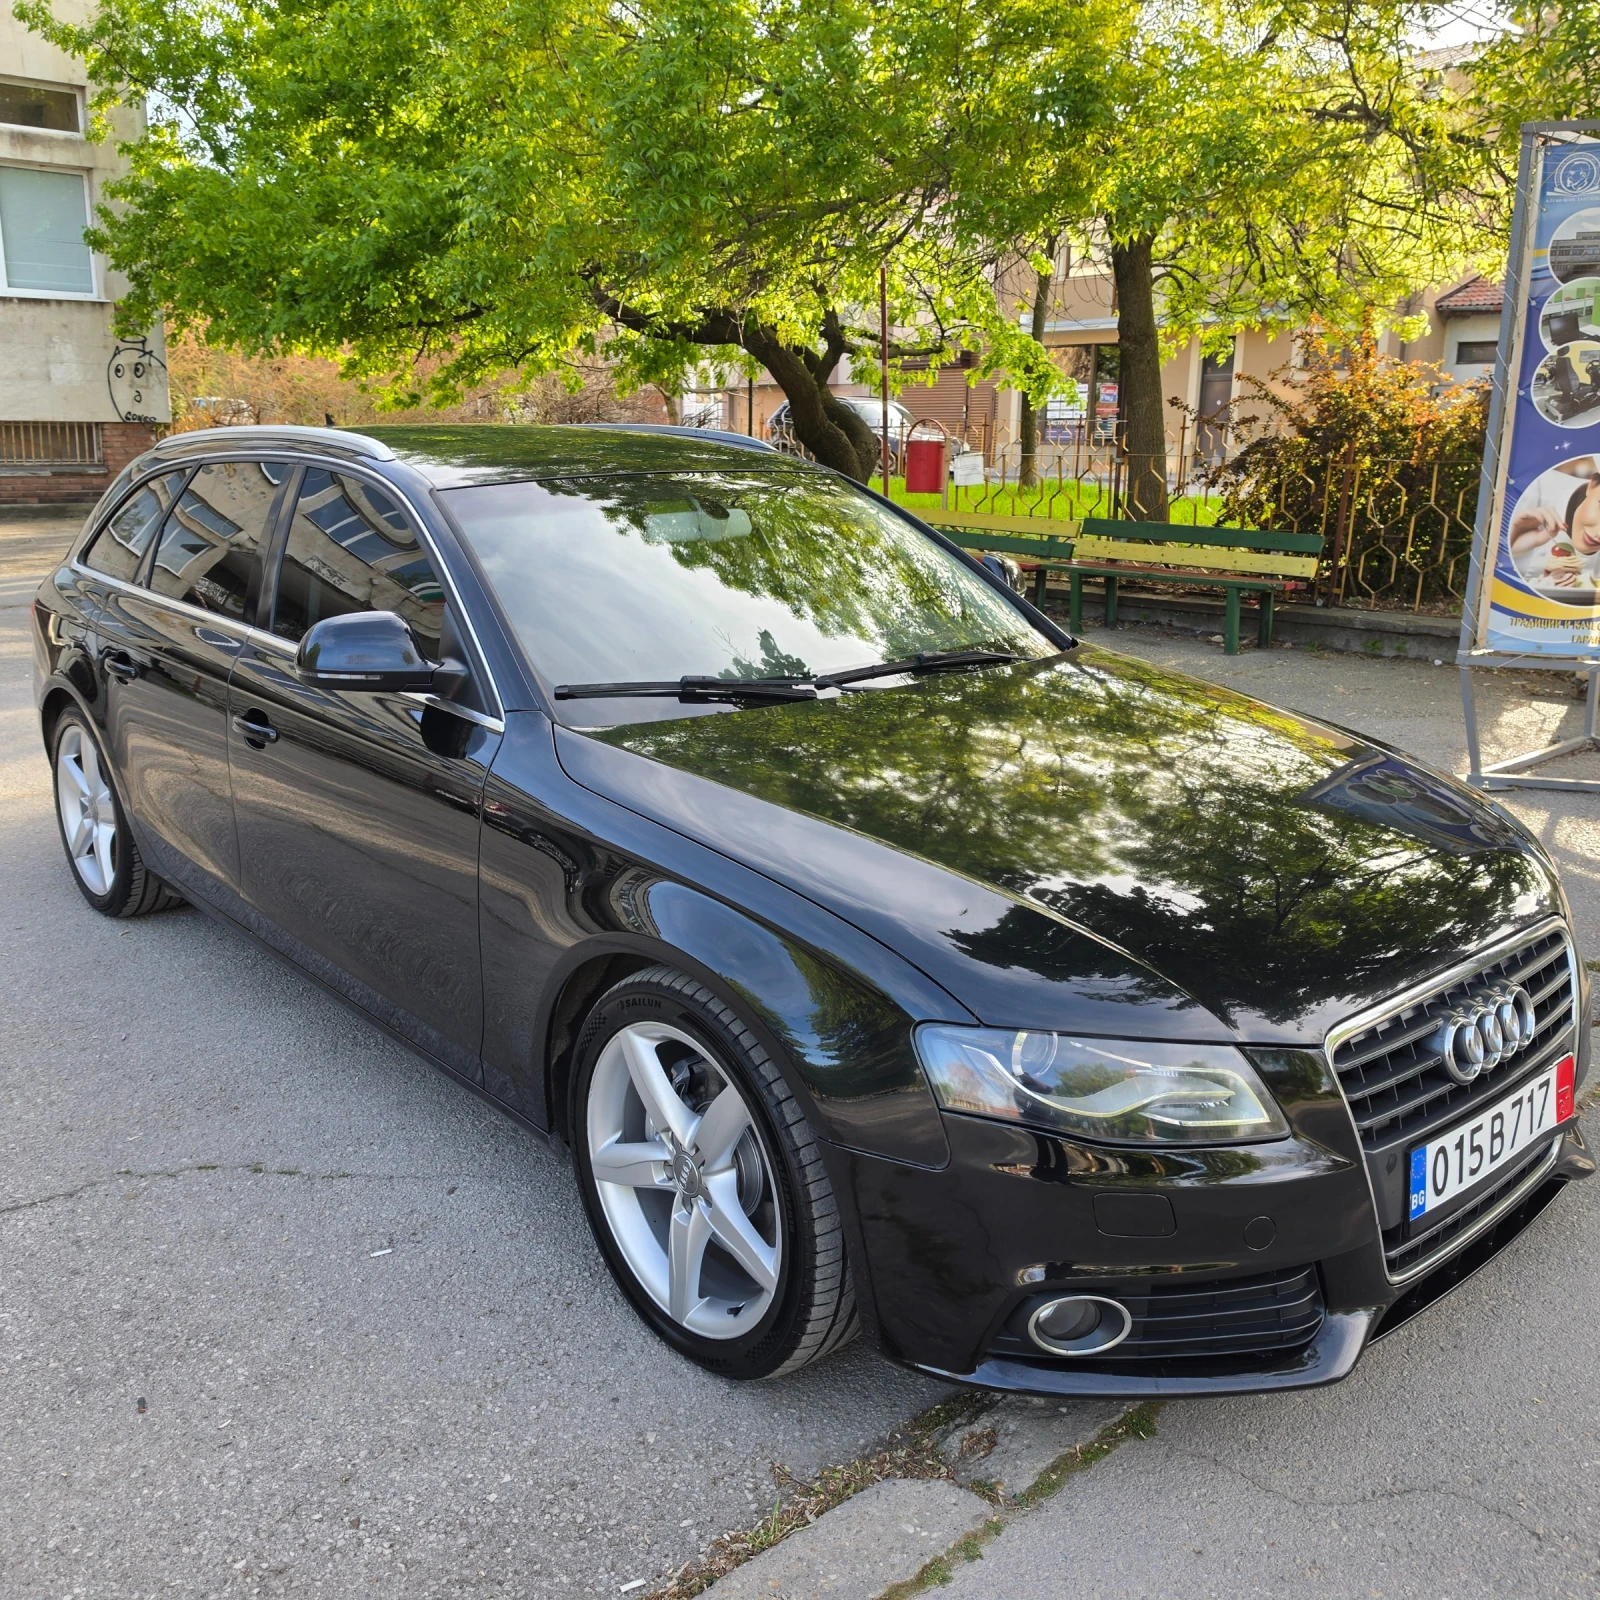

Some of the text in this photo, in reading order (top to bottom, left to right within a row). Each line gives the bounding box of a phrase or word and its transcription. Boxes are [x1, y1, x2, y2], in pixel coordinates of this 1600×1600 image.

[1101, 387, 1116, 395] Easy
[1101, 394, 1114, 402] Pay
[1510, 617, 1560, 629] ТРАДИЦИИ
[1563, 620, 1569, 629] И
[625, 997, 661, 1009] SAILUN
[1432, 1077, 1551, 1197] 015B717
[1411, 1190, 1425, 1211] BG
